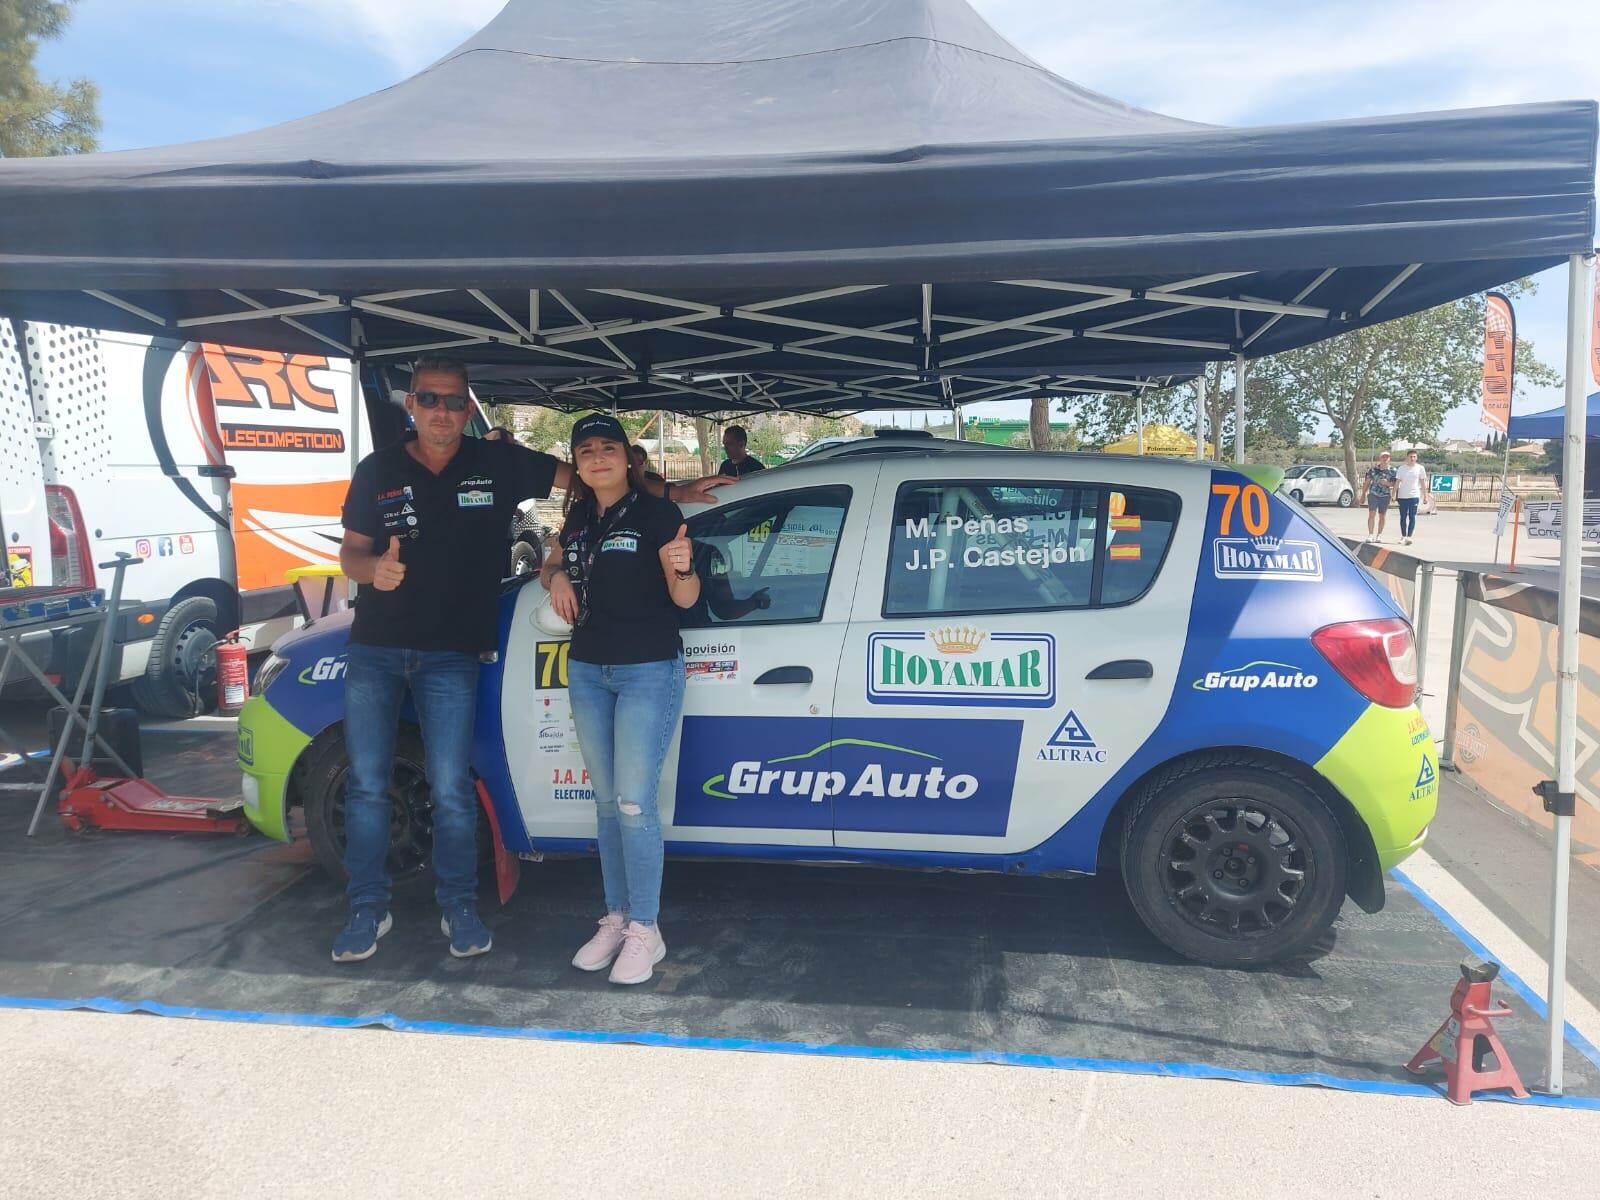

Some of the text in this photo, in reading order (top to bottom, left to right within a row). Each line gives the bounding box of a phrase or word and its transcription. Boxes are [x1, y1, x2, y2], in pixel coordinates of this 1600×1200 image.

[1212, 484, 1270, 536] 70
[749, 520, 771, 543] 46
[905, 518, 937, 539] M.
[946, 514, 1029, 537] Peñas
[905, 542, 1085, 571] J.P. Castejón
[1221, 545, 1315, 571] HOYAMAR
[684, 643, 736, 657] govisión
[312, 656, 346, 680] Gr
[880, 644, 1042, 687] HOYAMAR
[1204, 671, 1318, 691] Grup Auto
[1036, 748, 1107, 763] ALTRAC
[552, 769, 591, 784] J.A. P
[728, 760, 978, 802] Grup Auto
